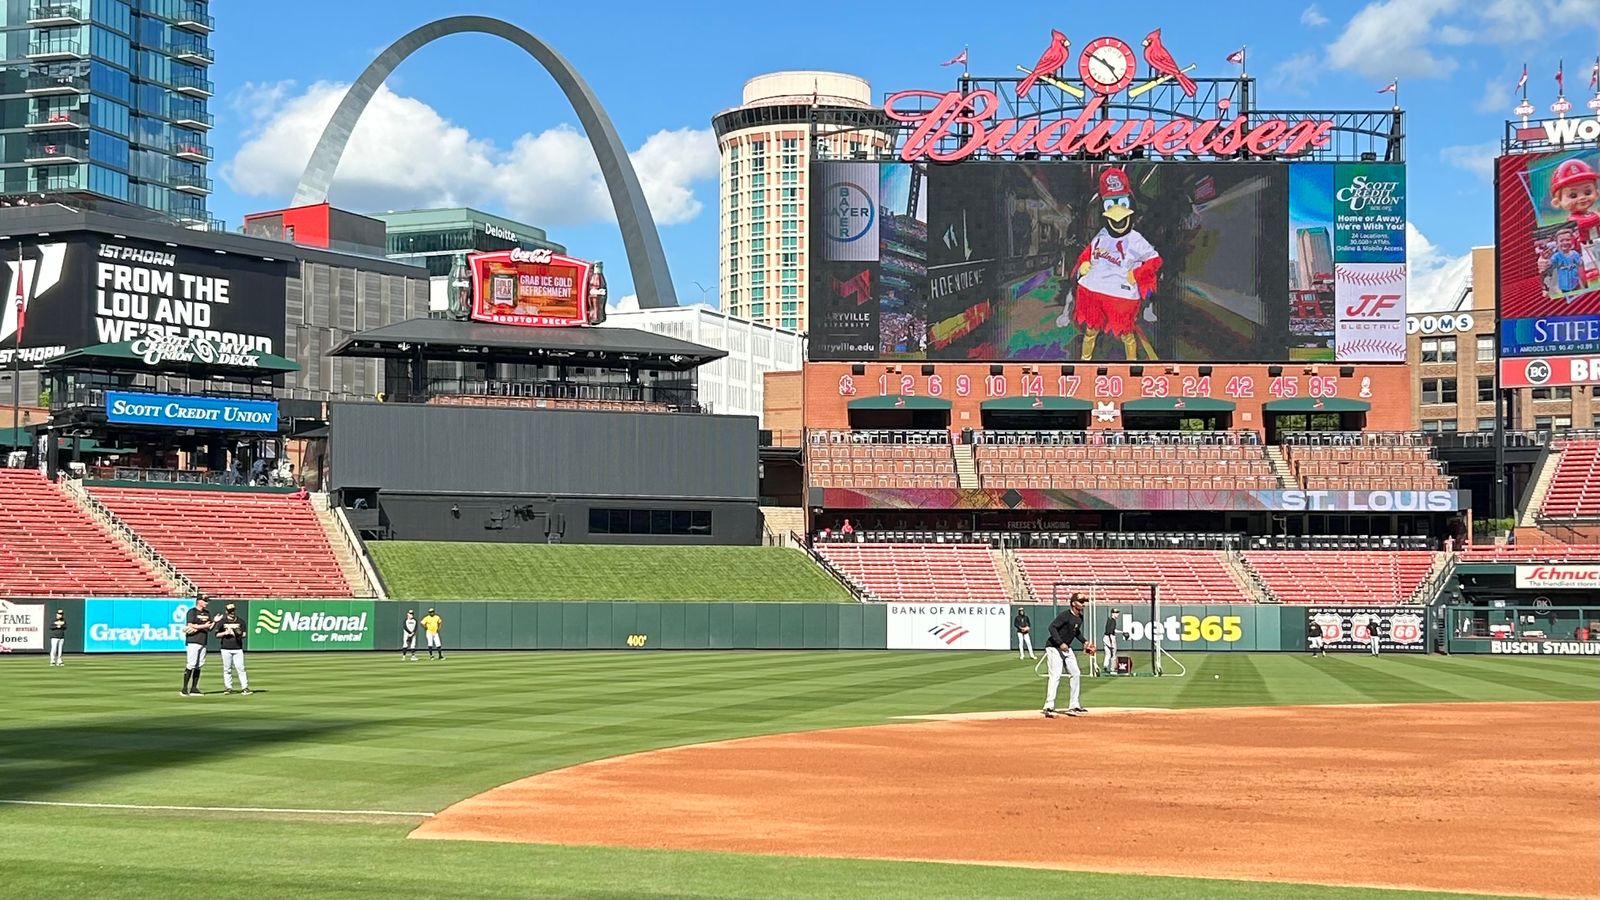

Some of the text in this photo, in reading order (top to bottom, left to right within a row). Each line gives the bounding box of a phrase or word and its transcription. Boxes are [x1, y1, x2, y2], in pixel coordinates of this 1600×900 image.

[885, 89, 1333, 162] Budweiser
[1351, 175, 1399, 190] SCOTT
[1336, 187, 1393, 201] CREDIT
[1350, 196, 1400, 210] UNION
[823, 207, 869, 217] AYER
[840, 187, 849, 237] BAYER
[1337, 214, 1363, 222] Home
[1376, 214, 1402, 223] Away,
[510, 247, 552, 264] Coca-Cola
[97, 262, 230, 304] FROM THE
[520, 275, 540, 286] GRAB
[541, 276, 553, 287] ICE
[520, 285, 572, 298] REFRESHMENT
[97, 290, 210, 328] LOU AND
[493, 315, 568, 325] ROOFTOP DECK
[1407, 317, 1469, 330] TUMS
[1534, 319, 1600, 343] STIFE
[218, 342, 253, 355] MVP
[143, 348, 194, 366] UNION
[217, 353, 260, 367] DECK
[1529, 359, 1600, 381] BC BR
[879, 374, 887, 396] 1
[901, 374, 915, 396] 2
[928, 374, 942, 396] 6
[956, 374, 970, 396] 9
[985, 375, 1007, 397] 10
[1021, 375, 1044, 397] 14
[1058, 375, 1081, 397] 17
[1095, 375, 1123, 397] 20
[1141, 375, 1169, 398] 23
[1182, 375, 1211, 398] 24
[1225, 376, 1254, 398] 42
[1269, 376, 1298, 398] 45
[1308, 376, 1338, 398] 85
[112, 400, 272, 424] SCOTT CREDIT UNION
[1281, 490, 1452, 511] ST. LOUIS
[1524, 567, 1600, 580] Schnuc
[891, 606, 1006, 616] BANK OF AMERICA
[3, 614, 31, 624] FAME
[1122, 613, 1242, 641] bet365
[1394, 625, 1416, 637] 66
[1, 634, 28, 644] Jones
[311, 633, 362, 642] Car Rental
[1491, 640, 1600, 655] BUSCH STADIU
